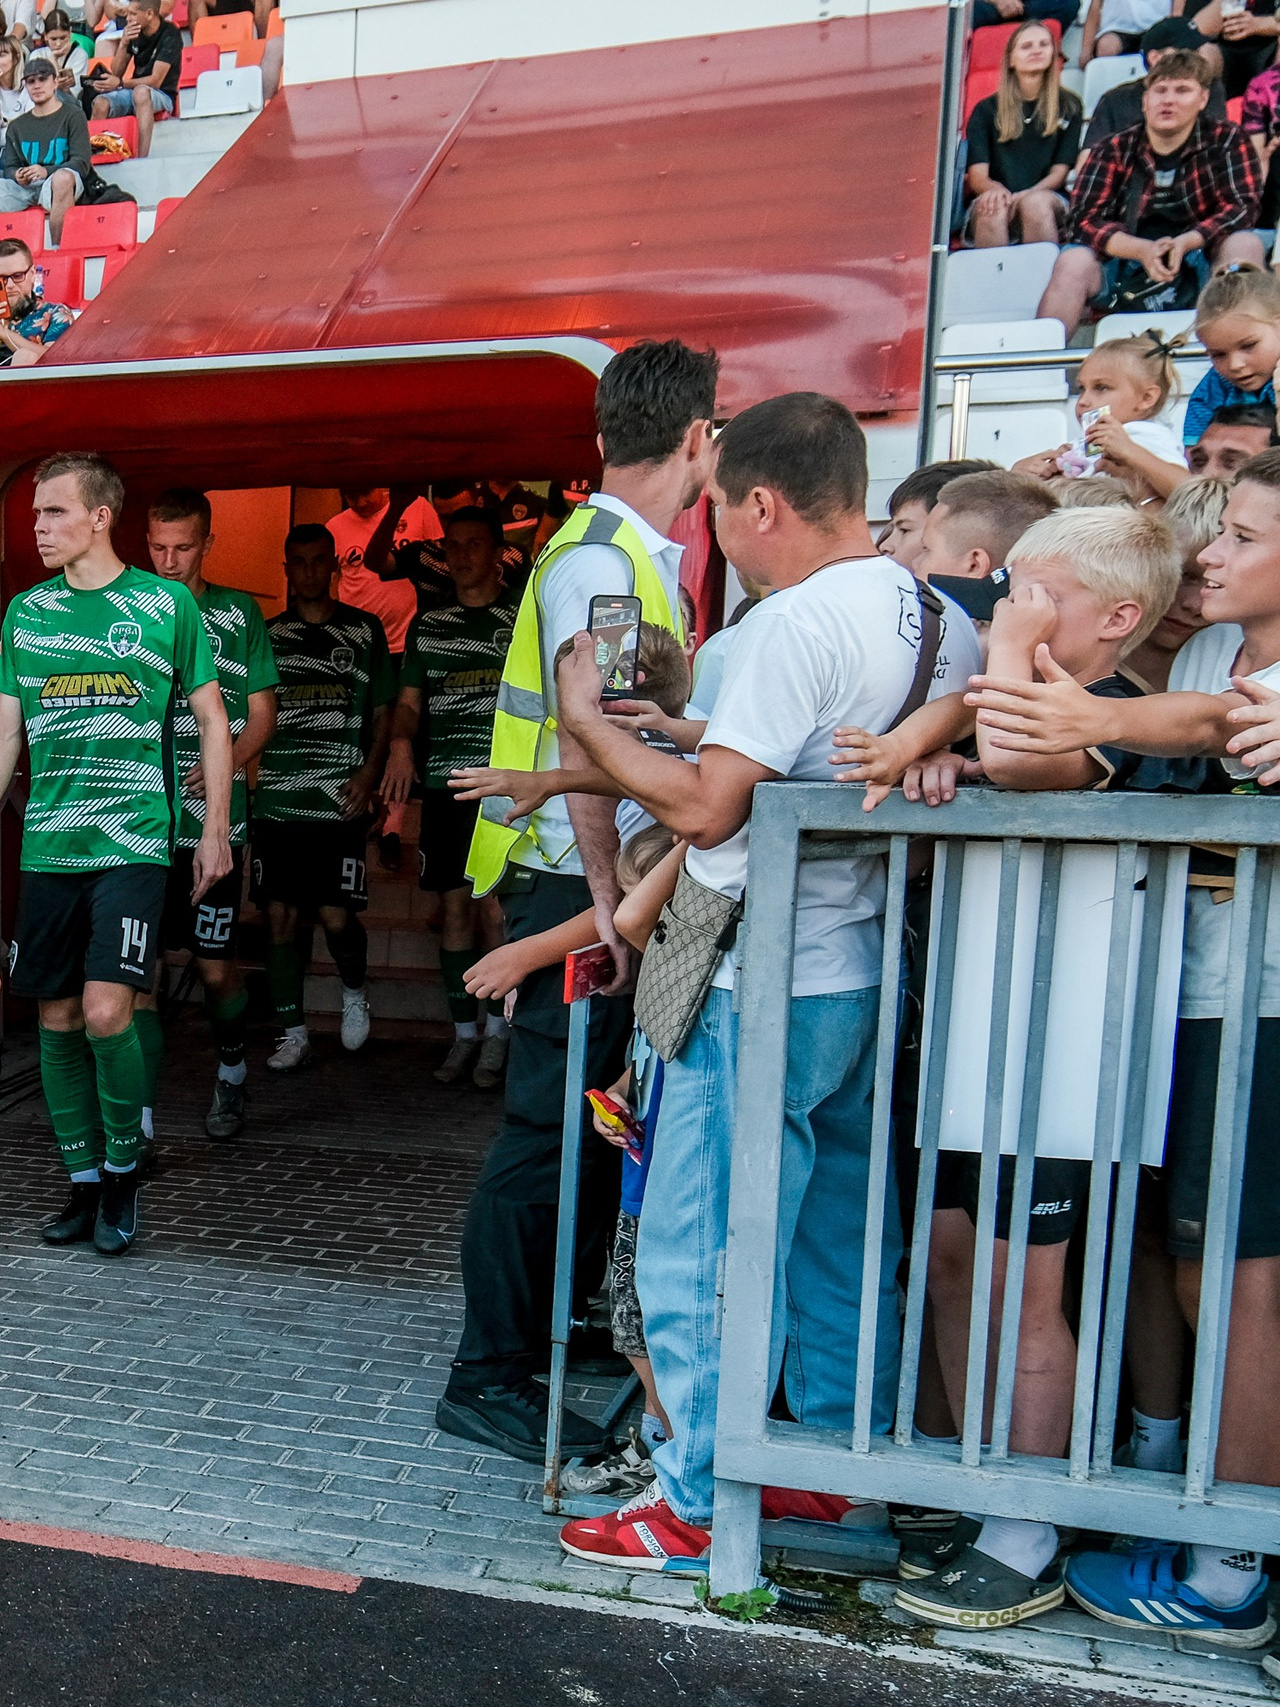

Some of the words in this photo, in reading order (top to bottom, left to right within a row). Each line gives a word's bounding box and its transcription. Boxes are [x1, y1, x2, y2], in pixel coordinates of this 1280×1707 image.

[41, 673, 140, 698] СПОРИМ!
[41, 696, 140, 708] ВЗЛЕТИМ
[195, 904, 233, 941] 22
[121, 917, 148, 963] 14
[1220, 1558, 1256, 1572] adidas
[958, 1607, 1020, 1626] crocs
